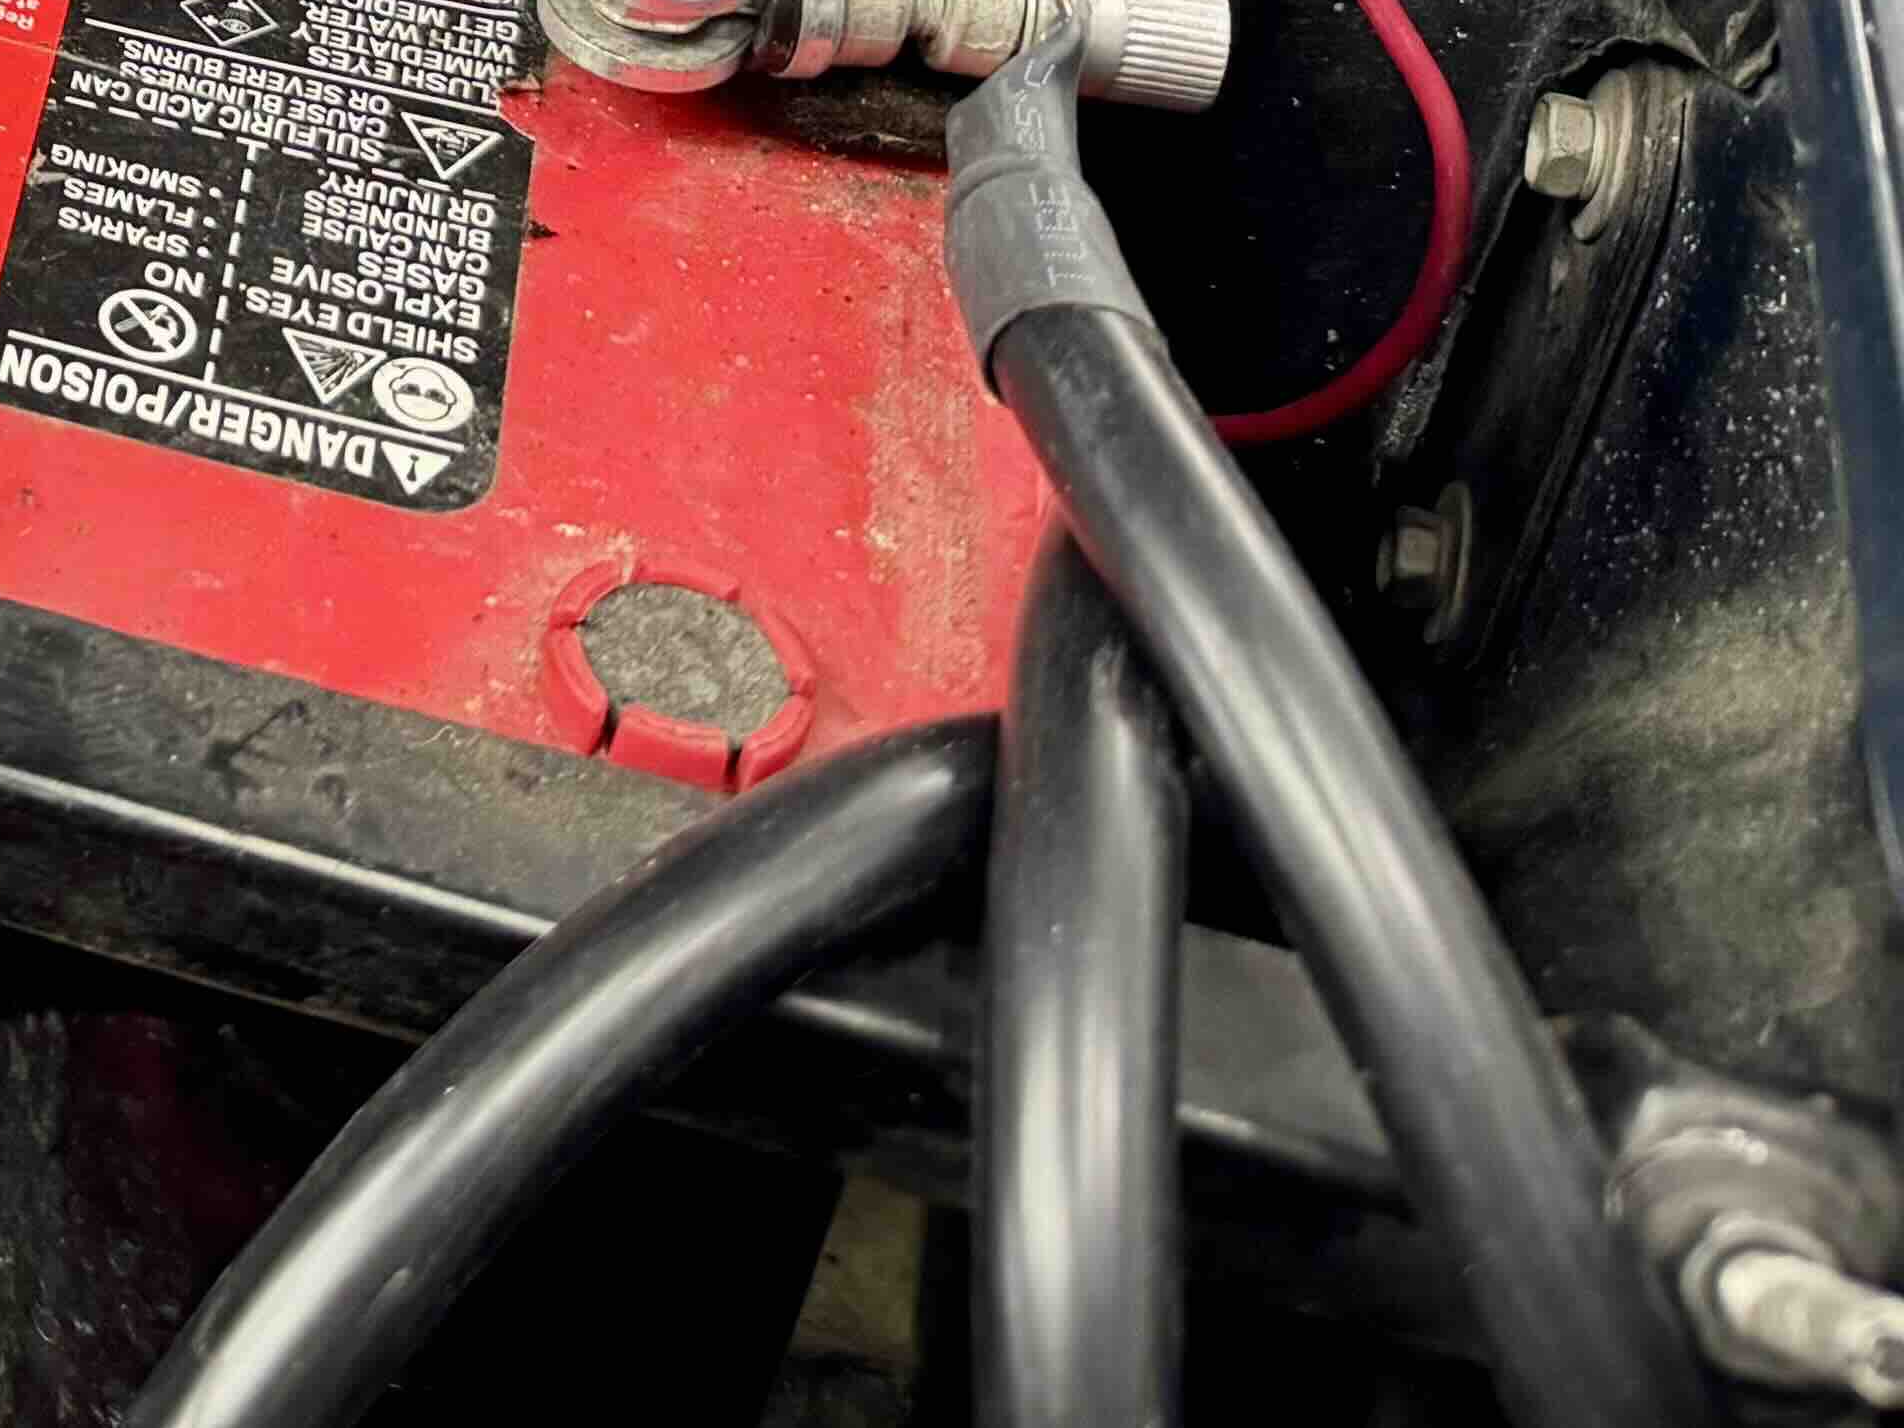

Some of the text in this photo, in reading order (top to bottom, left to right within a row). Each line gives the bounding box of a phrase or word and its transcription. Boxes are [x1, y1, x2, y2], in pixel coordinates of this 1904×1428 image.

[427, 28, 515, 65] WITH
[451, 8, 519, 43] GET
[114, 36, 391, 115] OR SEVERE BURNS.
[305, 44, 394, 81] EYES
[68, 69, 384, 163] SULFURIC ACID CAN
[116, 58, 387, 139] CAUSE BLINDNESS
[47, 141, 201, 198] SMOKING
[314, 165, 494, 227] OR INJURY.
[60, 174, 194, 227] FLAMES
[301, 186, 491, 254] BLINDNESS
[55, 204, 191, 258] SPARKS
[299, 210, 489, 278] CAN CAUSE
[141, 258, 205, 295] NO
[268, 253, 481, 332] EXPLOSIVE
[355, 248, 486, 303] GASES
[233, 280, 479, 365] SHIELD EYES.
